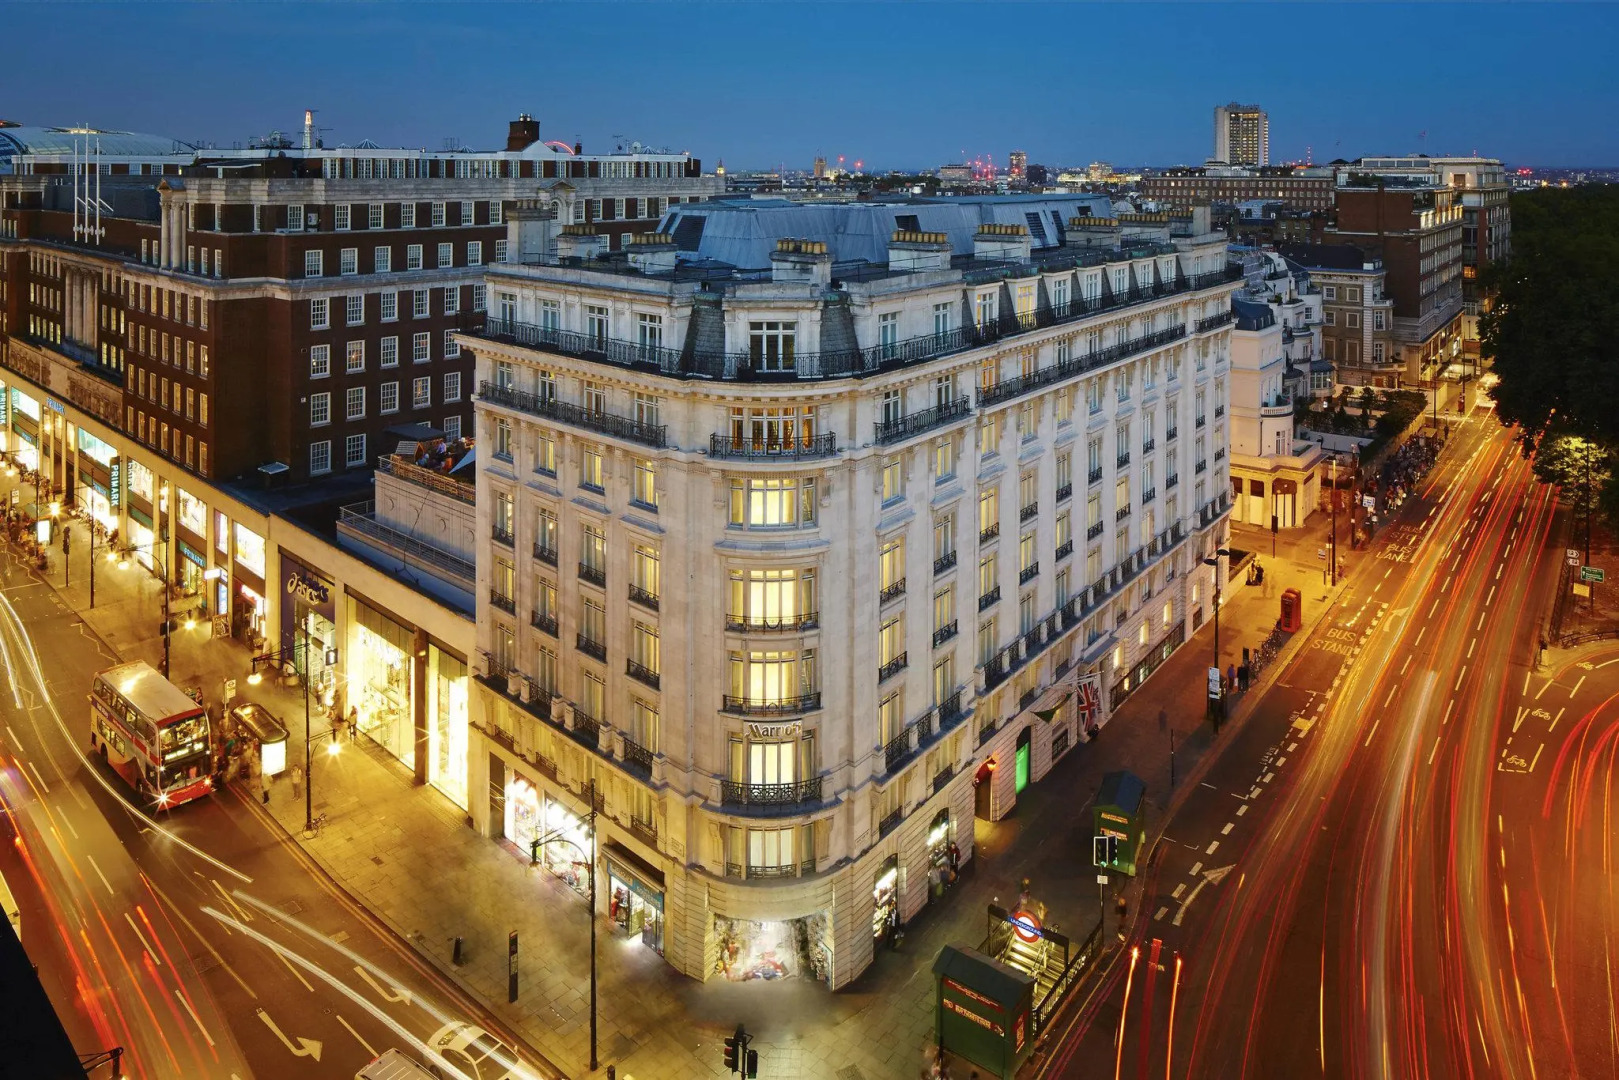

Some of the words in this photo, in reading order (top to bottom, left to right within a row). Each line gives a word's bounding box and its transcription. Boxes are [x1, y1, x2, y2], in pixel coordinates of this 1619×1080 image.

[111, 464, 119, 507] PRIMARK
[1326, 627, 1356, 642] BUS
[1311, 639, 1354, 657] STAND
[1010, 917, 1043, 936] UNDERGROUND
